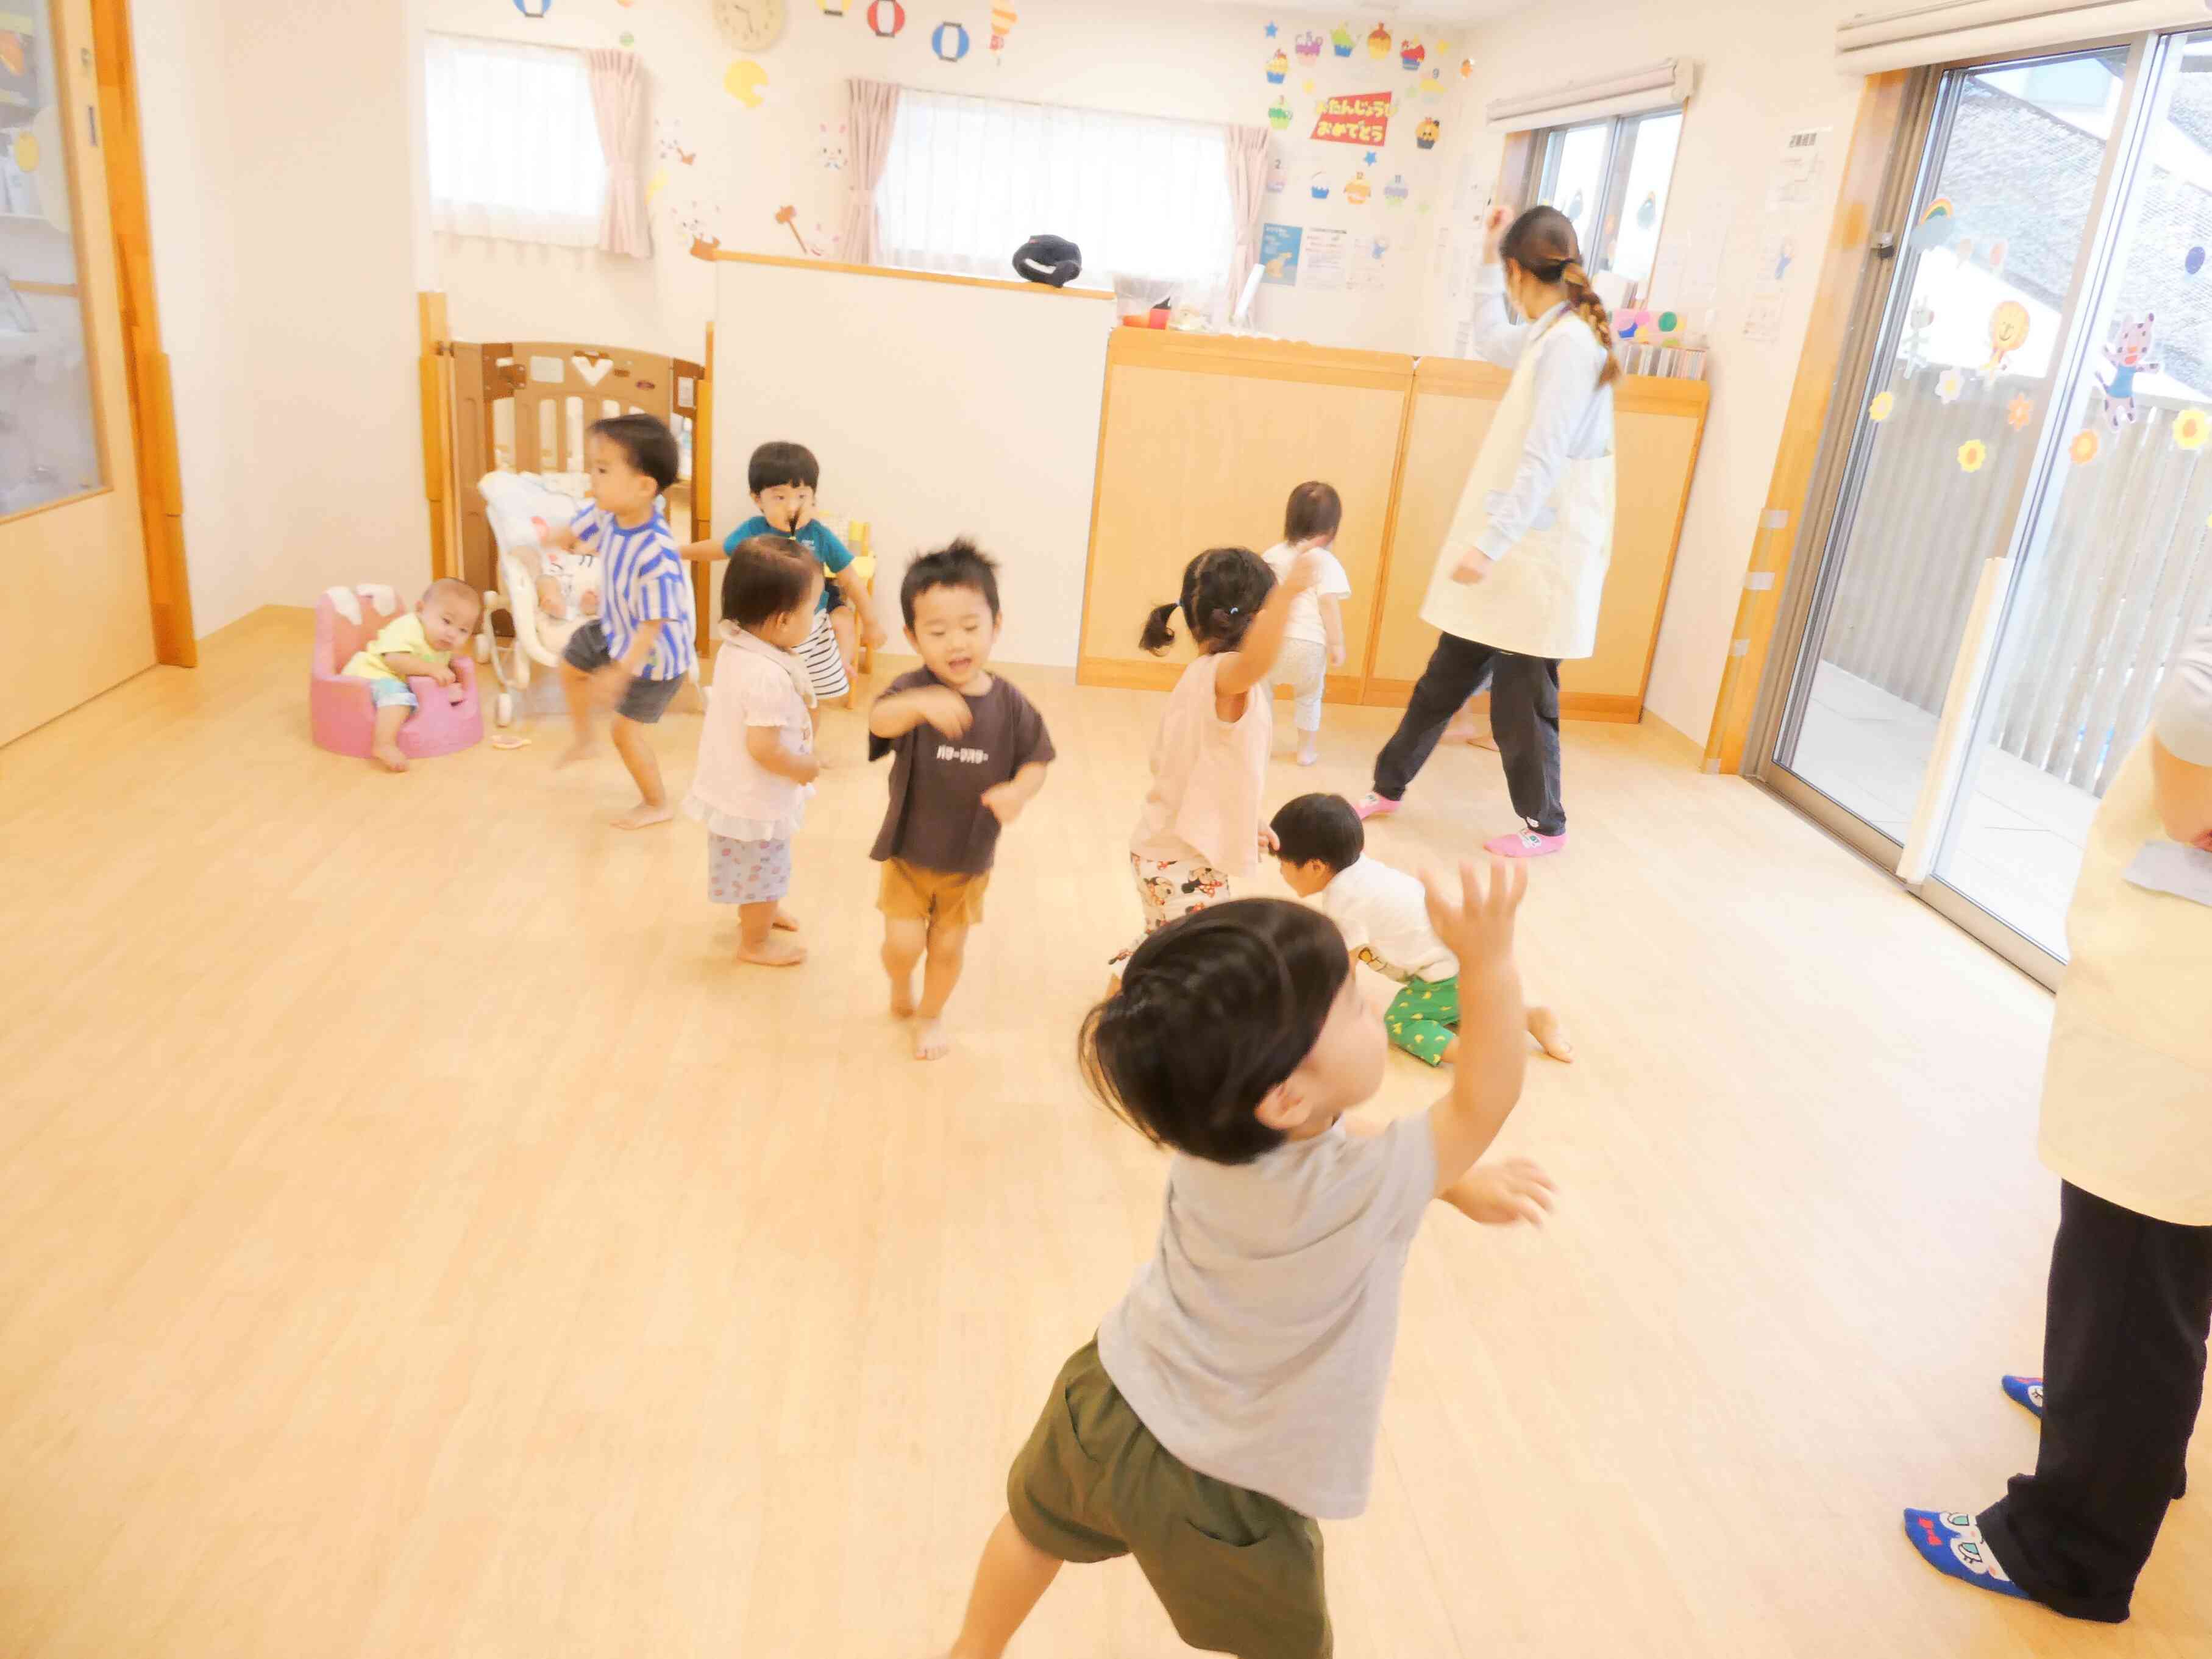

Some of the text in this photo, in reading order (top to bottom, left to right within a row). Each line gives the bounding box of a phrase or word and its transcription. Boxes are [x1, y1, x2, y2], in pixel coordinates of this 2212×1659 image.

[1317, 119, 1383, 142] おめでとう
[1275, 158, 1281, 169] 2
